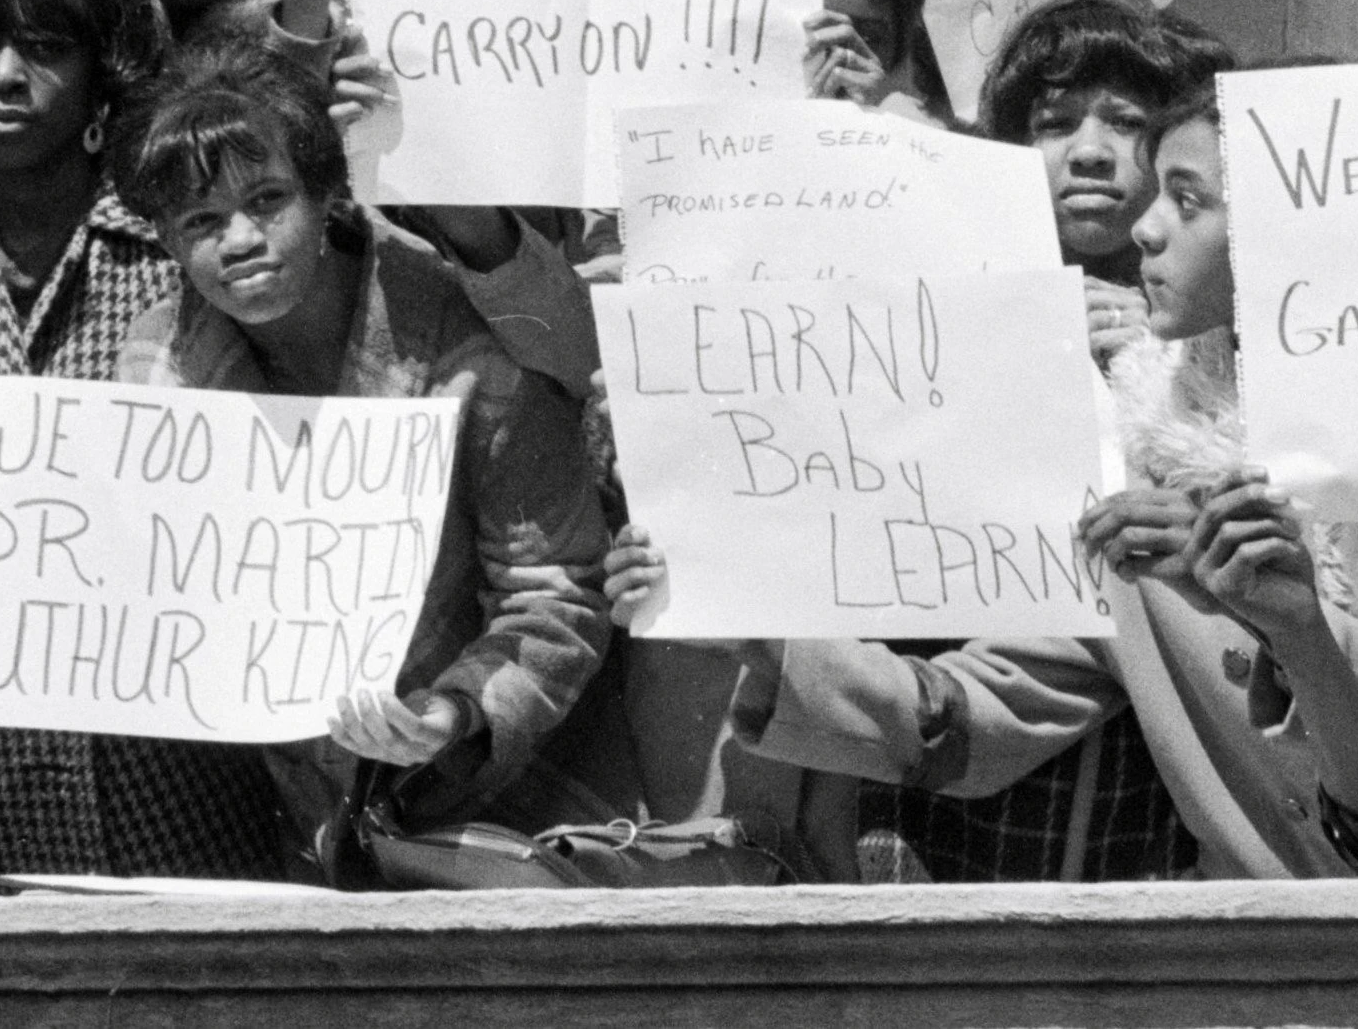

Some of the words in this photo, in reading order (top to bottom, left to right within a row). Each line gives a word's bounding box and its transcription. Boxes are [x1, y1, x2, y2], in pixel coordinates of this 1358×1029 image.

[817, 129, 891, 147] SEEN
[639, 189, 785, 218] PROMISED
[627, 276, 943, 408] LEARN!
[110, 399, 214, 484] TOO
[242, 609, 407, 714] KING
